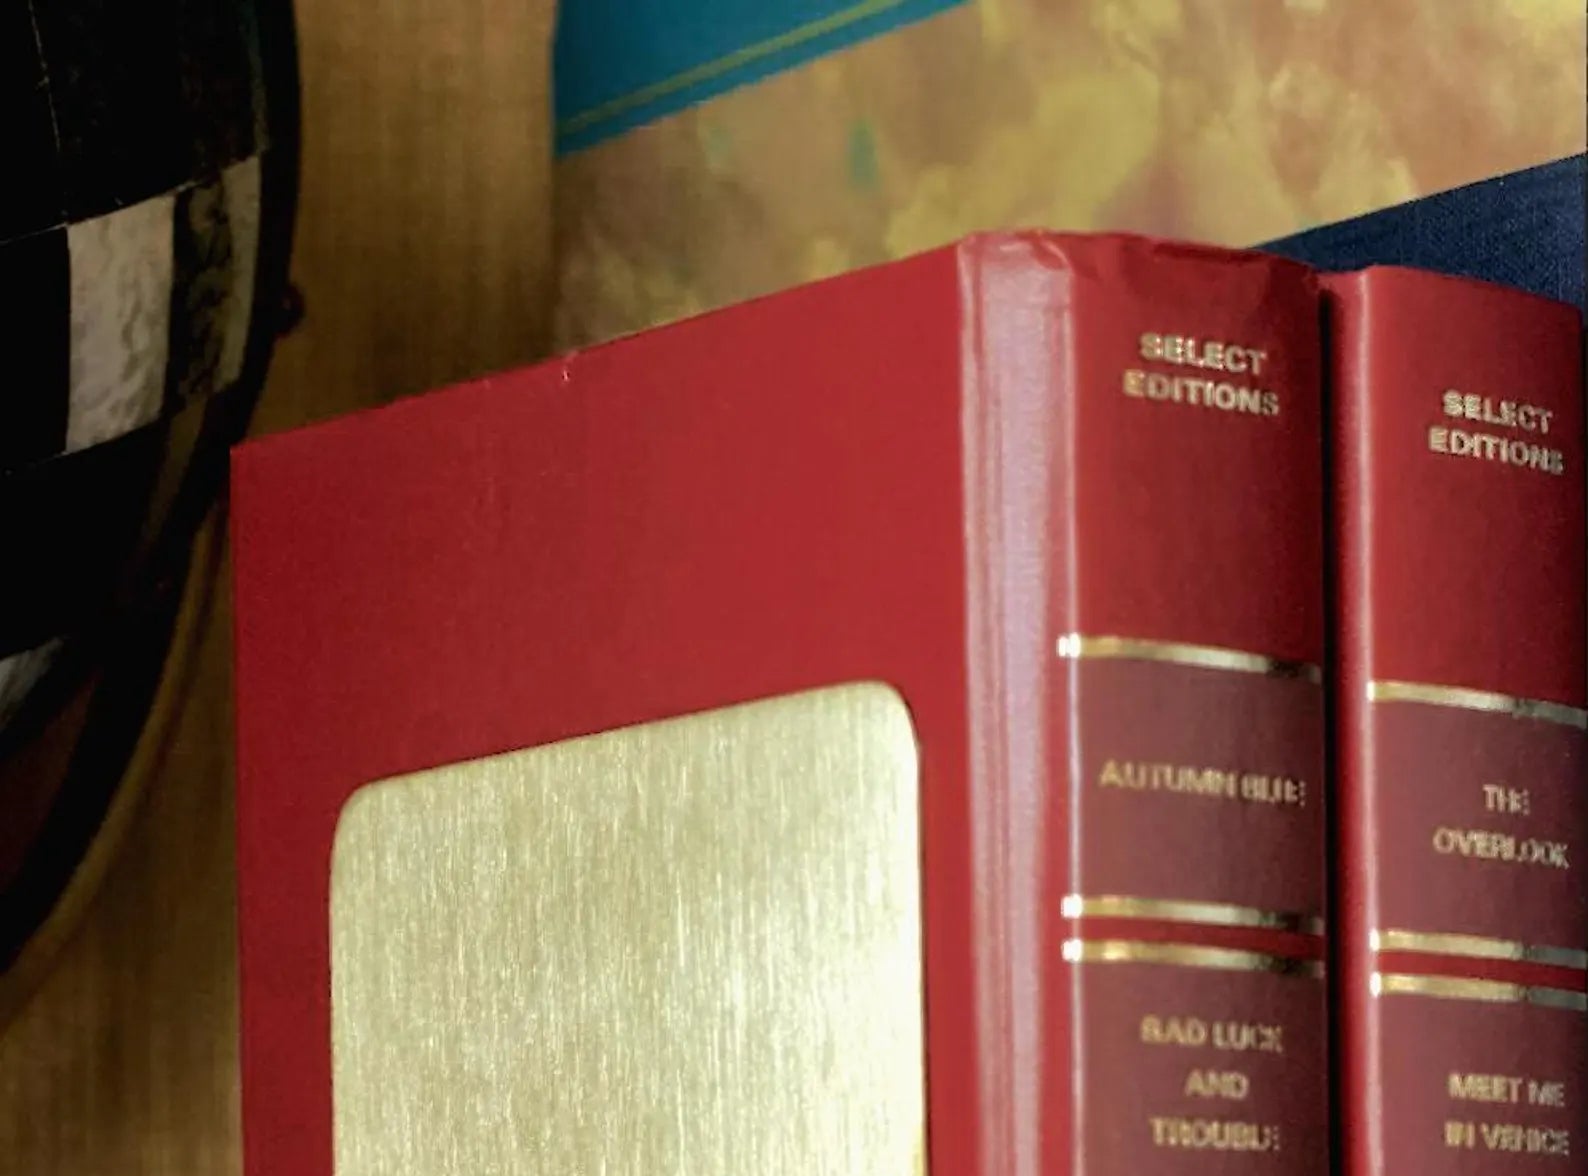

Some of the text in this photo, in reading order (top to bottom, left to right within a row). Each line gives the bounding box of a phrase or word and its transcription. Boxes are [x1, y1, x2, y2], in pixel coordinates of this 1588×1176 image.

[1140, 333, 1267, 375] SELECT
[1122, 368, 1281, 417] EDITIONS
[1443, 390, 1554, 433] SELECT
[1428, 426, 1564, 475] EDITIONS
[1140, 1015, 1208, 1046] BAD
[1184, 1071, 1249, 1100] AND
[1447, 1072, 1523, 1104] MEET
